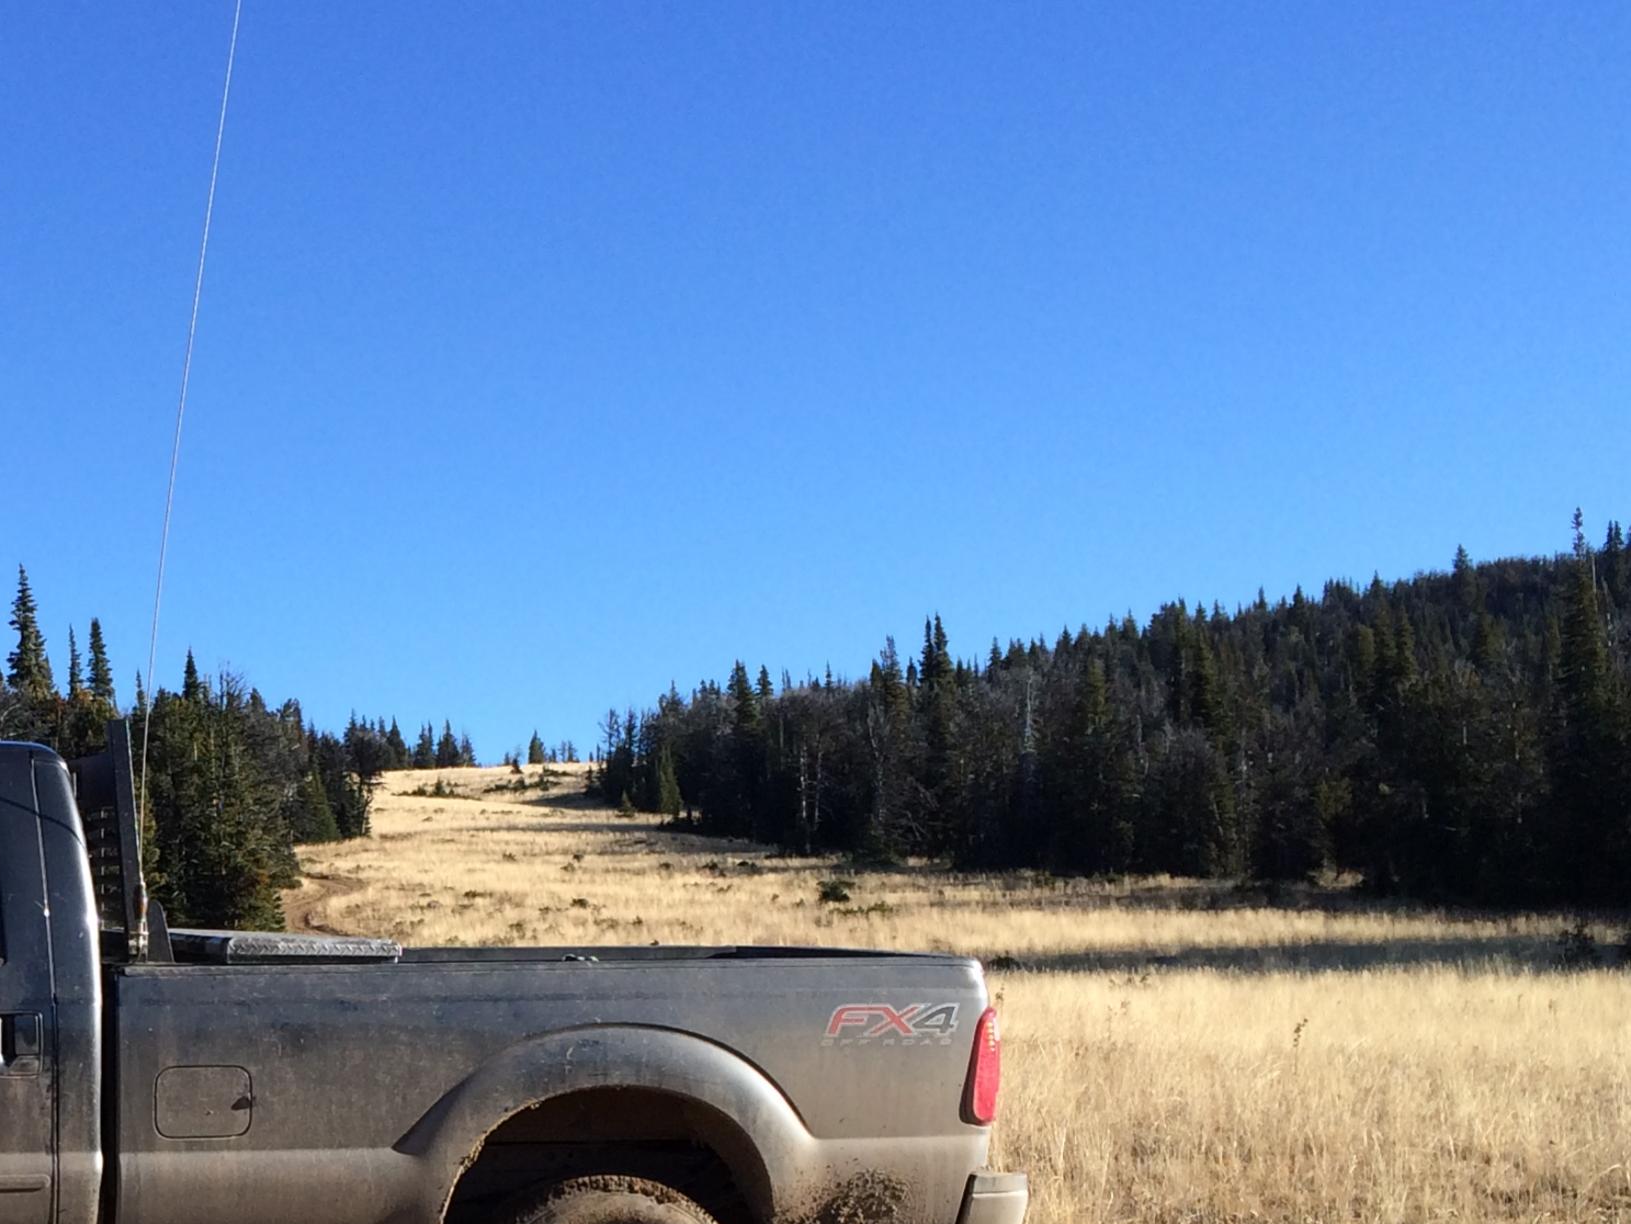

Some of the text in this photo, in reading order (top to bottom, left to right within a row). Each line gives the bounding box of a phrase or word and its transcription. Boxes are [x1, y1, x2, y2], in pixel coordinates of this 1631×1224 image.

[825, 1002, 960, 1036] FX4
[821, 1038, 952, 1046] OFF ROAD
